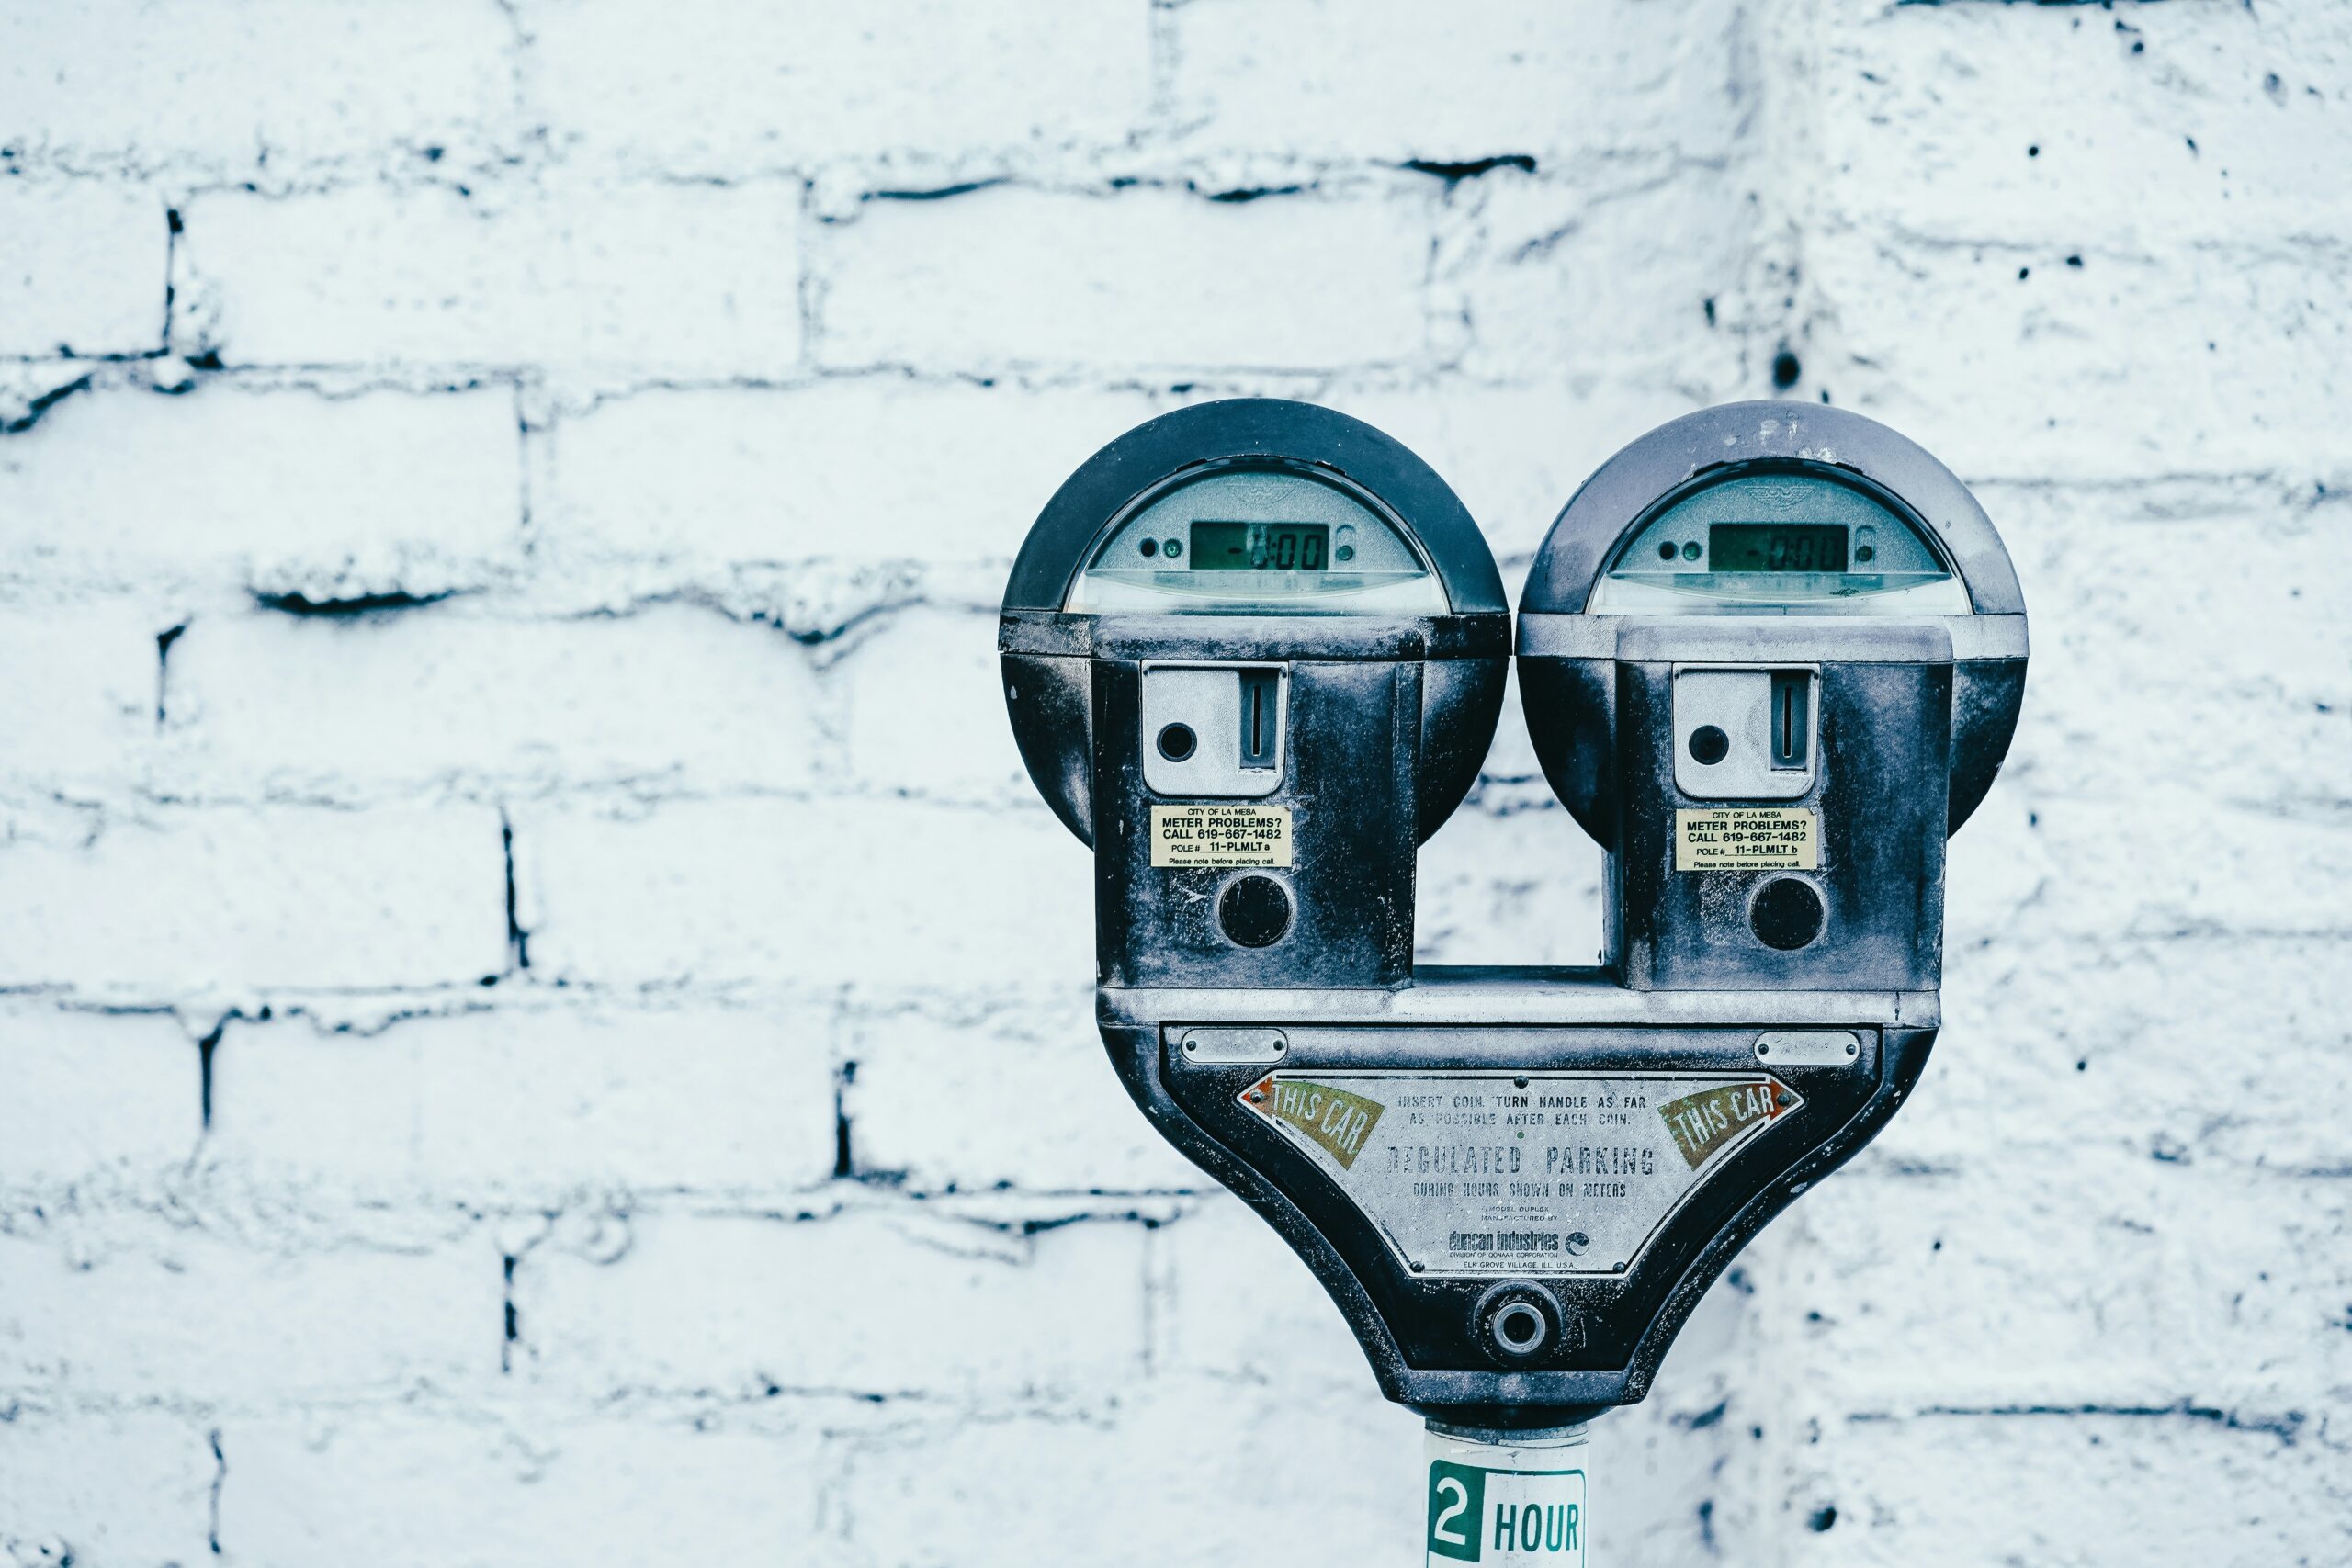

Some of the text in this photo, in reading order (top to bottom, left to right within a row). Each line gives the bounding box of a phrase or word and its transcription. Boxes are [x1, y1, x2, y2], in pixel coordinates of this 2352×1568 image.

[1162, 818, 1282, 828] METER PROBLEMS?
[1687, 820, 1807, 831] METER PROBLEMS?
[1162, 829, 1282, 839] CALL 619-667-1482
[1688, 832, 1807, 842] CALL 619-667-1482
[1171, 844, 1193, 852] POLE
[1209, 841, 1262, 852] 11-PLMLT
[1735, 845, 1789, 854] 11-PLMLT
[1792, 845, 1798, 853] b
[1236, 858, 1260, 866] placing
[1760, 861, 1785, 869] placing
[1398, 1096, 1442, 1108] INSERT
[1496, 1096, 1529, 1108] TURN
[1539, 1096, 1588, 1108] HANDLE
[1598, 1096, 1613, 1109] AS
[1623, 1096, 1646, 1109] FAR
[1272, 1085, 1368, 1155] THIS CAR
[1409, 1112, 1425, 1125] AS
[1435, 1112, 1496, 1125] POSSIBLE
[1506, 1112, 1544, 1125] AFTER
[1555, 1113, 1587, 1125] EACH
[1673, 1087, 1774, 1152] THIS CAR
[1387, 1145, 1653, 1175] REGULATED PARKING
[1413, 1182, 1626, 1198] DURING HOURS SHOWN ON METERS
[1449, 1230, 1559, 1251] duncan industries
[1434, 1476, 1579, 1552] 2 HOUR
